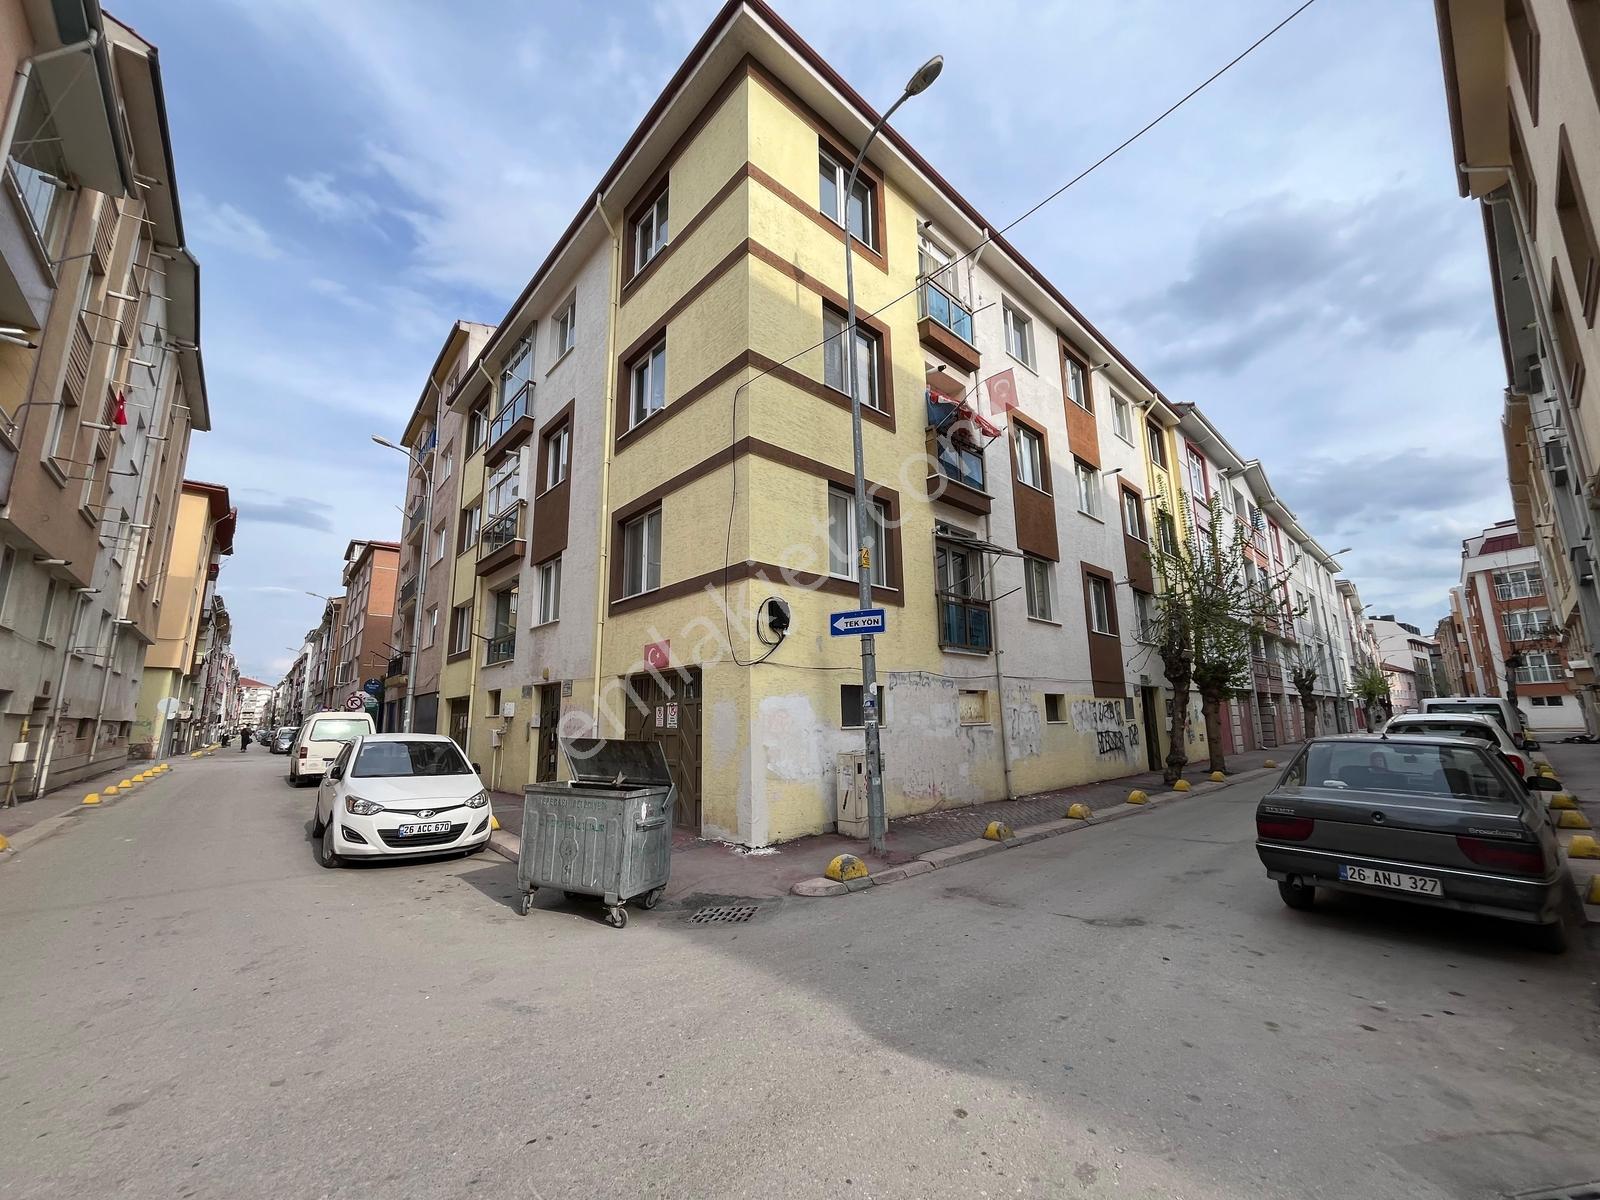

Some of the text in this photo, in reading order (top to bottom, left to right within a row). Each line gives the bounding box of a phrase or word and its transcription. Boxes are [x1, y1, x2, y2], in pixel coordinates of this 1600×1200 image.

[861, 618, 879, 626] YÖN
[403, 823, 450, 834] 26 ACC 670
[1348, 867, 1438, 893] 26 ANJ 327
